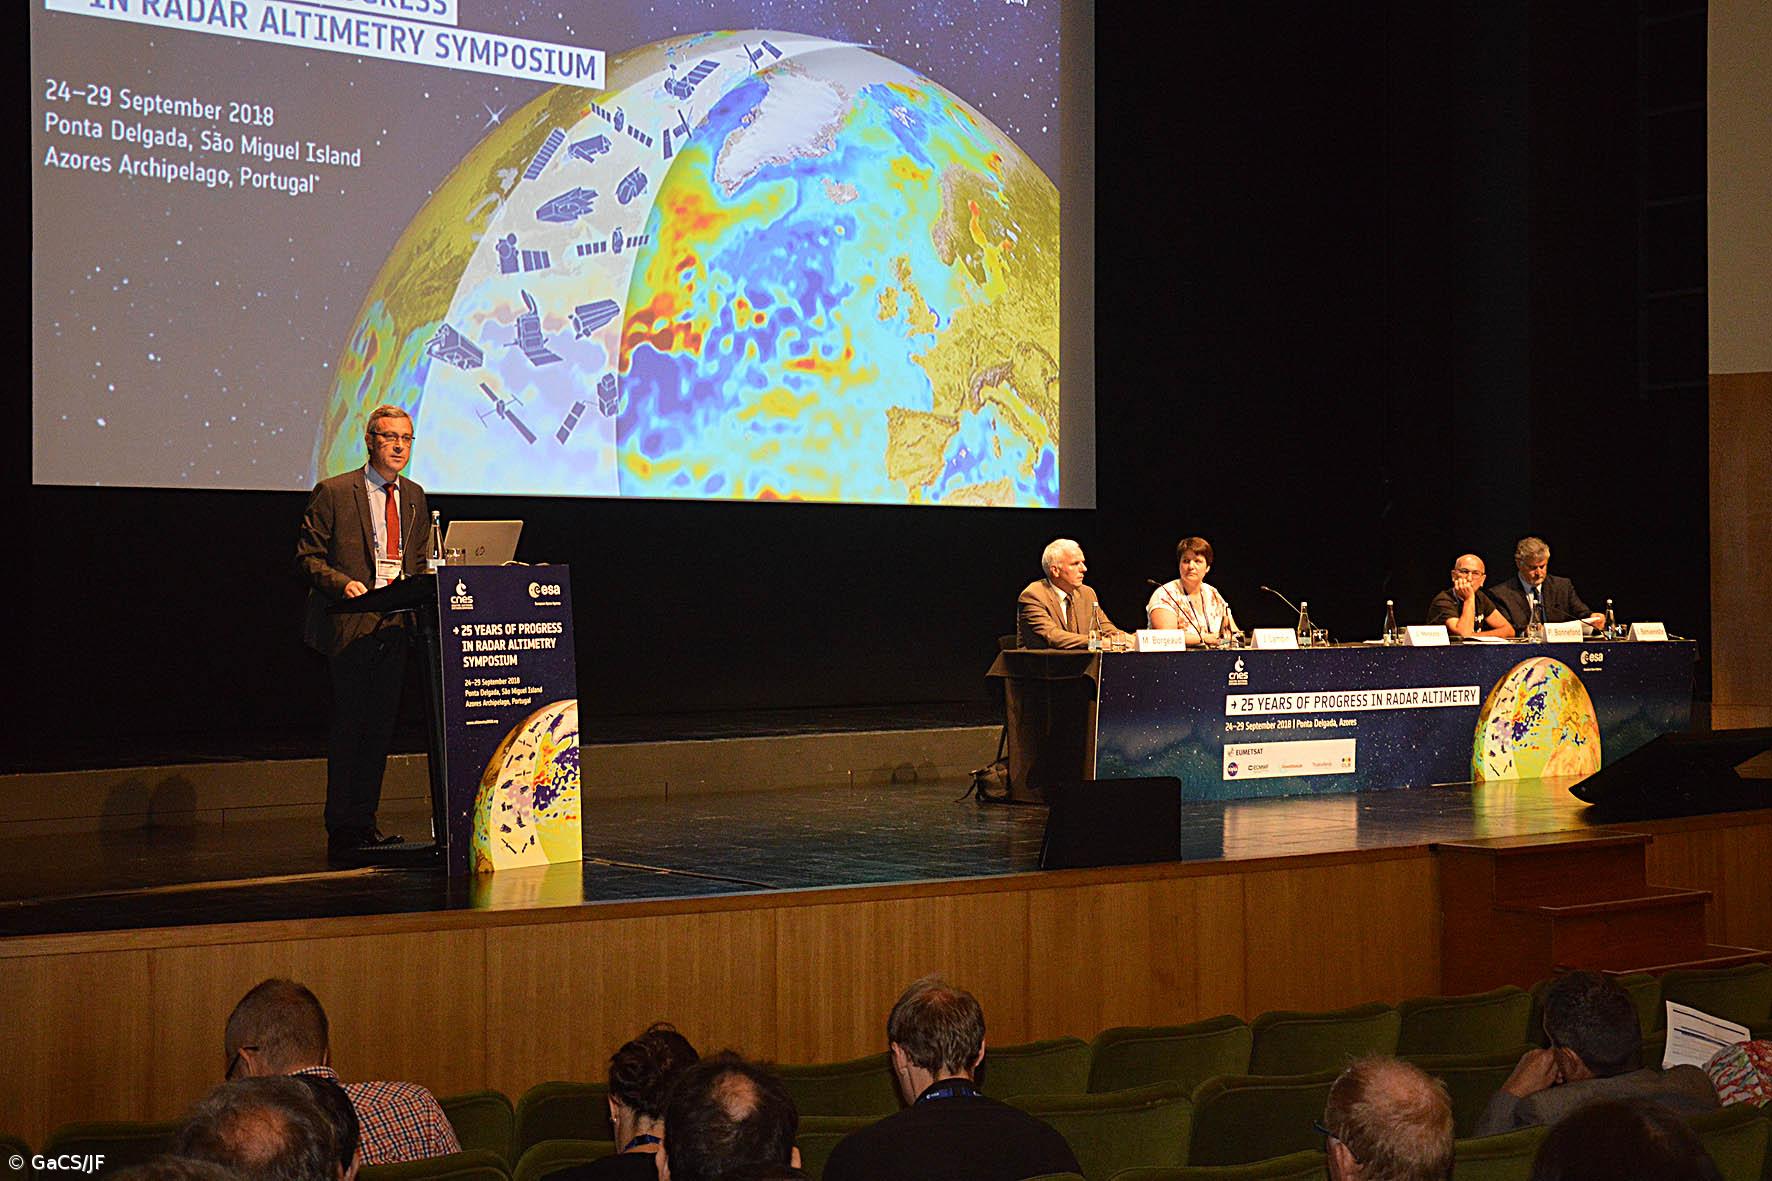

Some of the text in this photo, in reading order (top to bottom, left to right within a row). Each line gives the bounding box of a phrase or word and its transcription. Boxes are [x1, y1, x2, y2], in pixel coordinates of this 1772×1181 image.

[142, 0, 596, 81] RADAR ALTIMETRY SYMPOSIUM
[45, 79, 275, 127] 24–29 September 2018
[45, 112, 362, 167] Ponta Delgada, São Miguel Island
[44, 146, 315, 196] Azores Archipelago, Portugal
[450, 595, 474, 604] cnes
[461, 622, 563, 636] 25 YEARS OF PROGRESS
[462, 638, 557, 652] IN RADAR ALTIMETRY
[463, 654, 518, 668] SYMPOSIUM
[481, 677, 507, 687] September
[1241, 689, 1476, 711] 25 YEARS OF PROGRESS IN RADAR ALTIMETRY
[1245, 721, 1276, 732] September
[1276, 720, 1292, 729] 2018
[1296, 719, 1313, 728] Ponta
[1313, 718, 1338, 729] Delgada,
[1338, 718, 1358, 727] Azores
[1235, 748, 1264, 756] EUMETSAT
